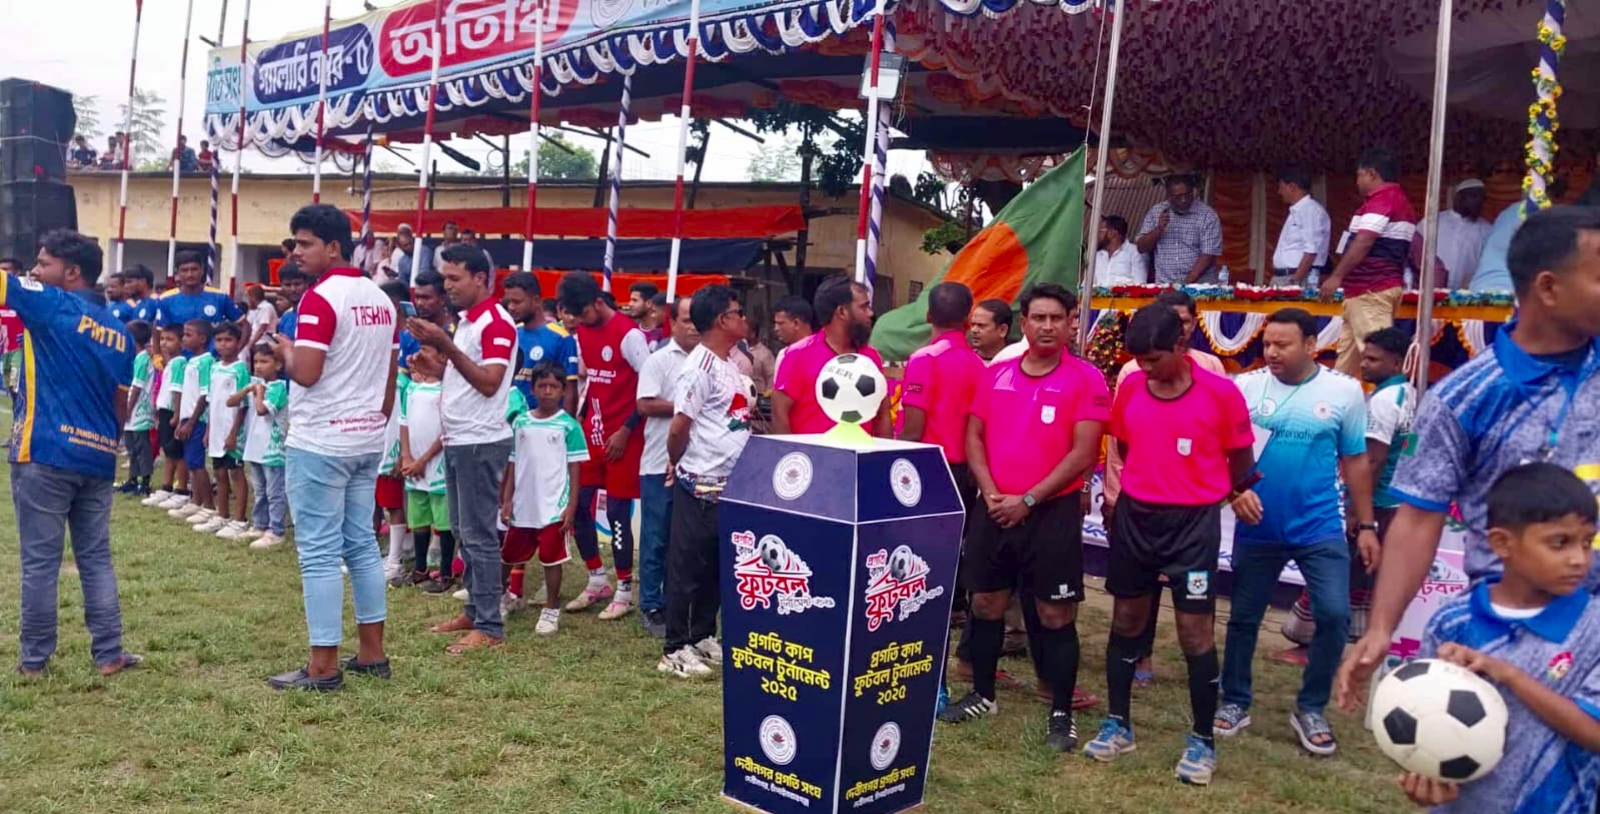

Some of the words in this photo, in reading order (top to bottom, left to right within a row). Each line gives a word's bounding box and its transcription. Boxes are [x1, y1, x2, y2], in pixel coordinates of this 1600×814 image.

[351, 304, 392, 327] TASKIN
[737, 563, 808, 608] ফুটবল
[867, 577, 925, 630] ফুটবল
[748, 631, 783, 654] প্রগতি
[784, 641, 814, 663] কাপ
[870, 641, 900, 668] প্রগতি
[901, 640, 923, 658] কাপ
[731, 646, 775, 673] ফুটবল
[776, 656, 831, 689] টুর্নামেন্ট
[854, 668, 891, 697] ফুটবল
[891, 655, 933, 687] টুর্নামেন্ট
[761, 676, 798, 701] ২০২৫
[877, 685, 906, 705] ২০২৫
[735, 756, 774, 780] দেবীনগর
[775, 771, 800, 790] প্রগতি
[801, 781, 822, 799] সংঘ
[846, 778, 879, 800] দেবীনগর
[879, 768, 899, 789] প্রগতি
[900, 765, 916, 780] সংঘ
